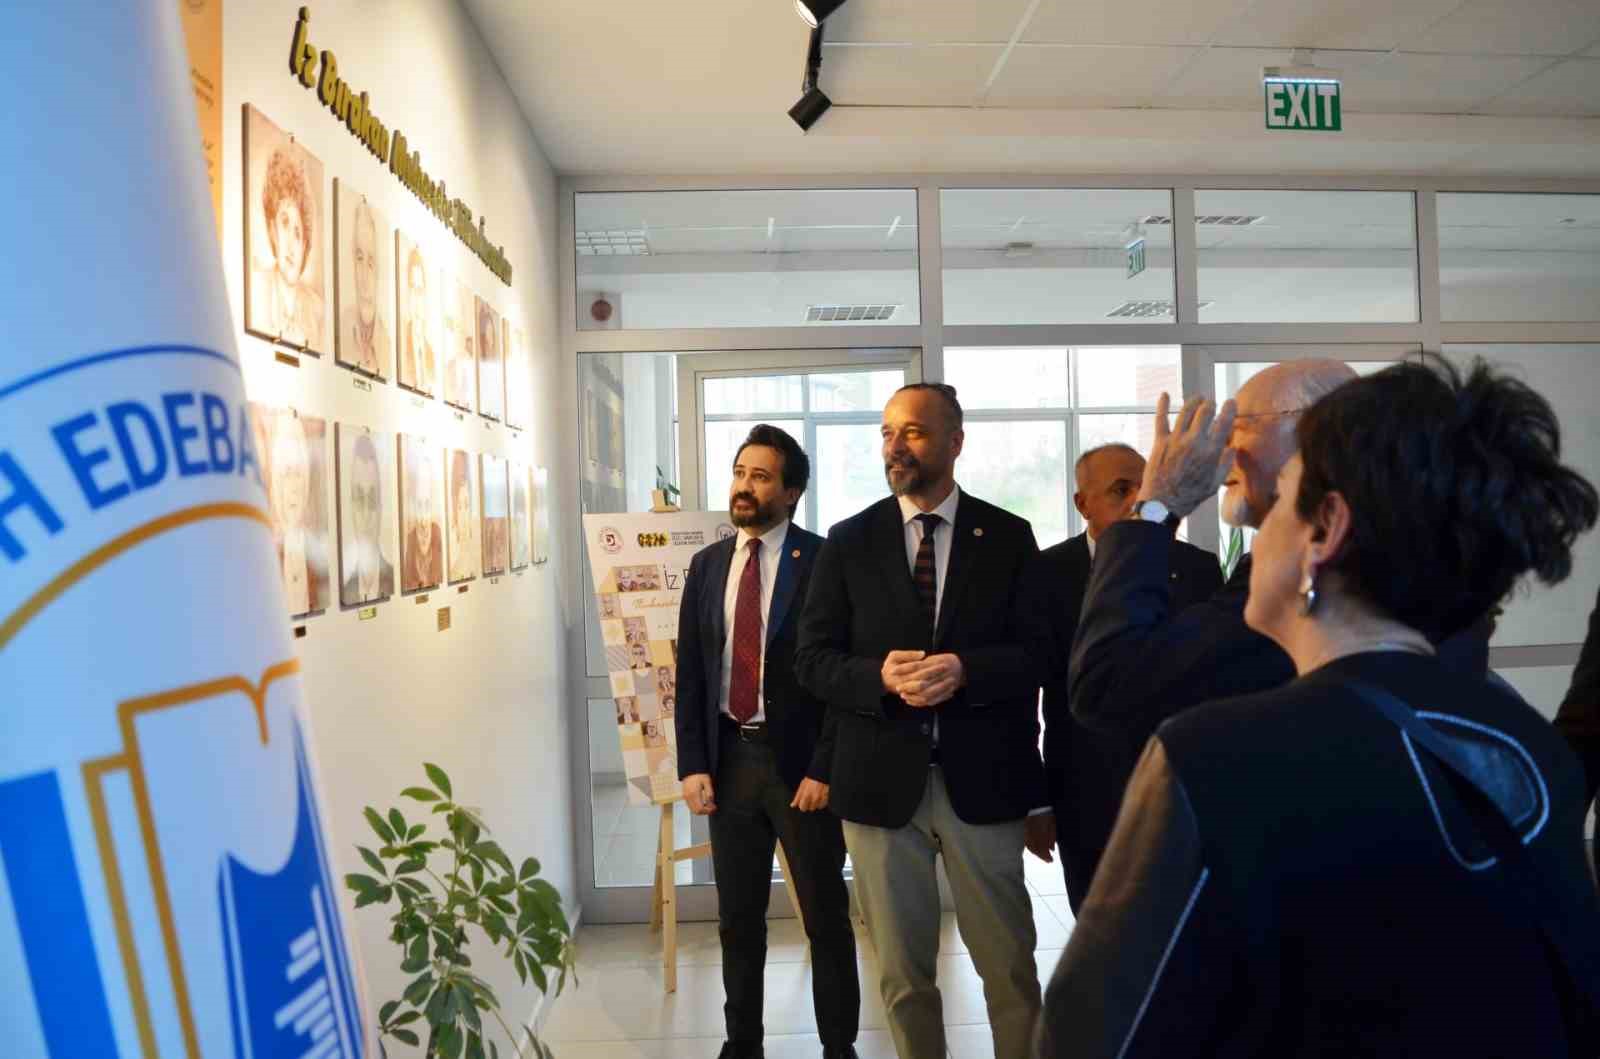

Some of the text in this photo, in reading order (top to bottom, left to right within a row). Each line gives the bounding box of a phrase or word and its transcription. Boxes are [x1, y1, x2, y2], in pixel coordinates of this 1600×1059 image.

[289, 6, 318, 89] İz
[317, 50, 390, 164] Bırakan
[1266, 83, 1337, 128] EXIT
